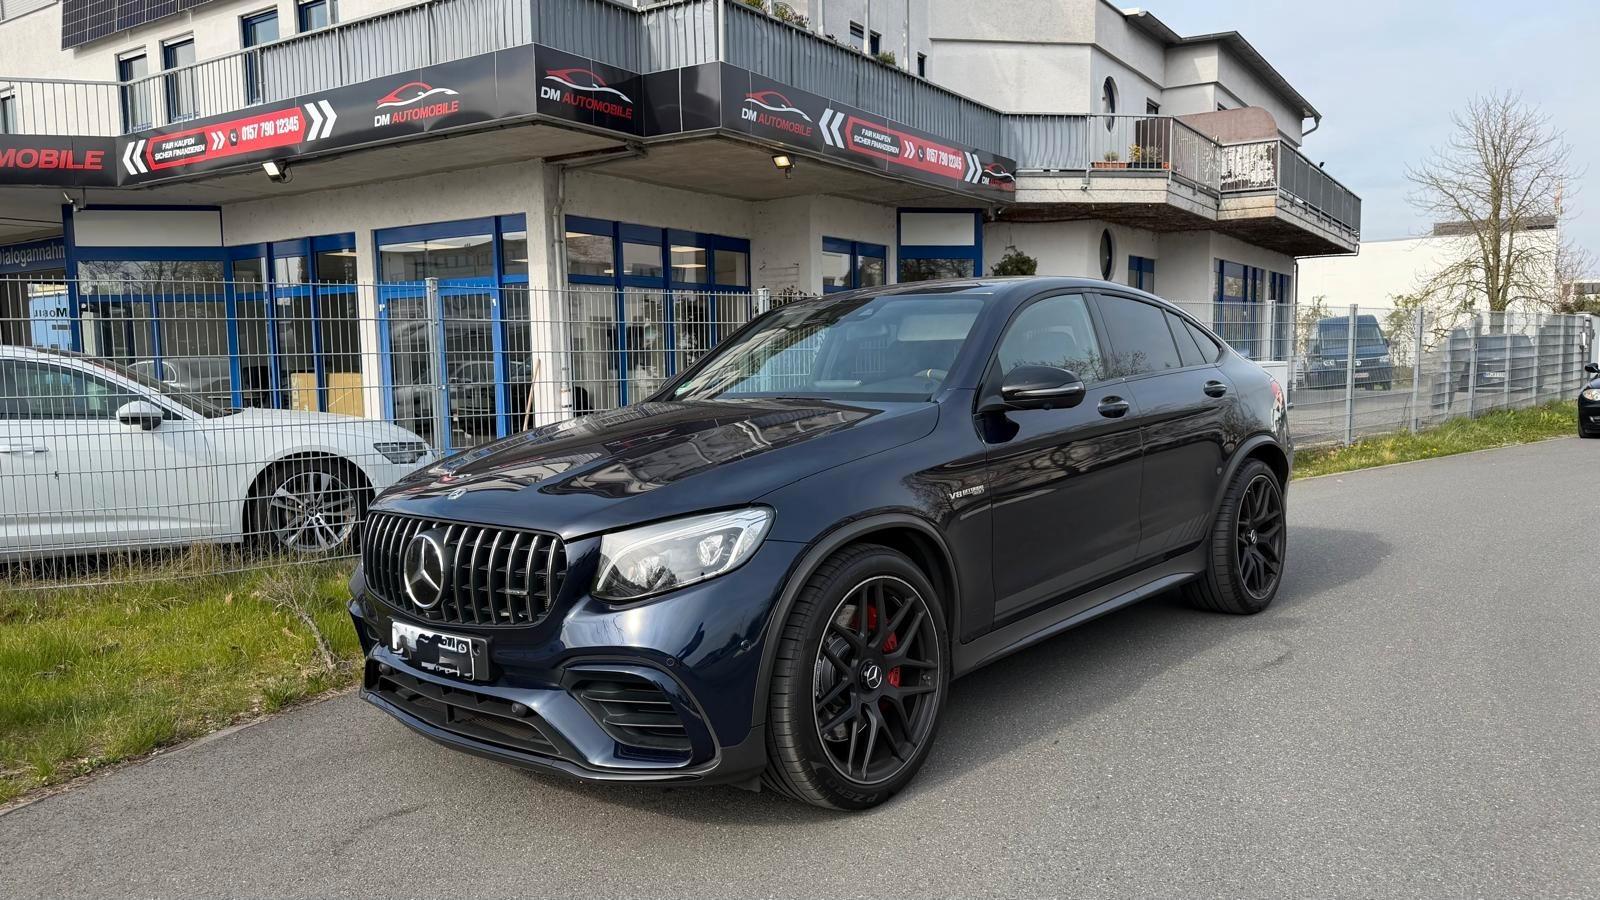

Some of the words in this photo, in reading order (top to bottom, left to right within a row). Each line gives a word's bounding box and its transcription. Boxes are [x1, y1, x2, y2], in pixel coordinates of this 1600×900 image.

[541, 86, 561, 101] DM
[563, 92, 632, 119] AUTOMOBILE
[374, 113, 390, 127] DM
[391, 100, 460, 124] AUTOMOBILE
[741, 107, 757, 121] DM
[758, 113, 813, 136] AUTOMOBILE
[241, 123, 259, 141] 0157
[260, 120, 275, 138] 790
[276, 115, 300, 135] 12345
[862, 128, 872, 137] FAIR
[162, 142, 174, 150] FAIR
[174, 137, 195, 148] KAUFEN
[853, 134, 871, 146] SICHER
[0, 148, 104, 169] MOBILE
[154, 150, 173, 161] SICHER
[172, 143, 206, 157] FINANZIEREN
[949, 490, 962, 499] V8
